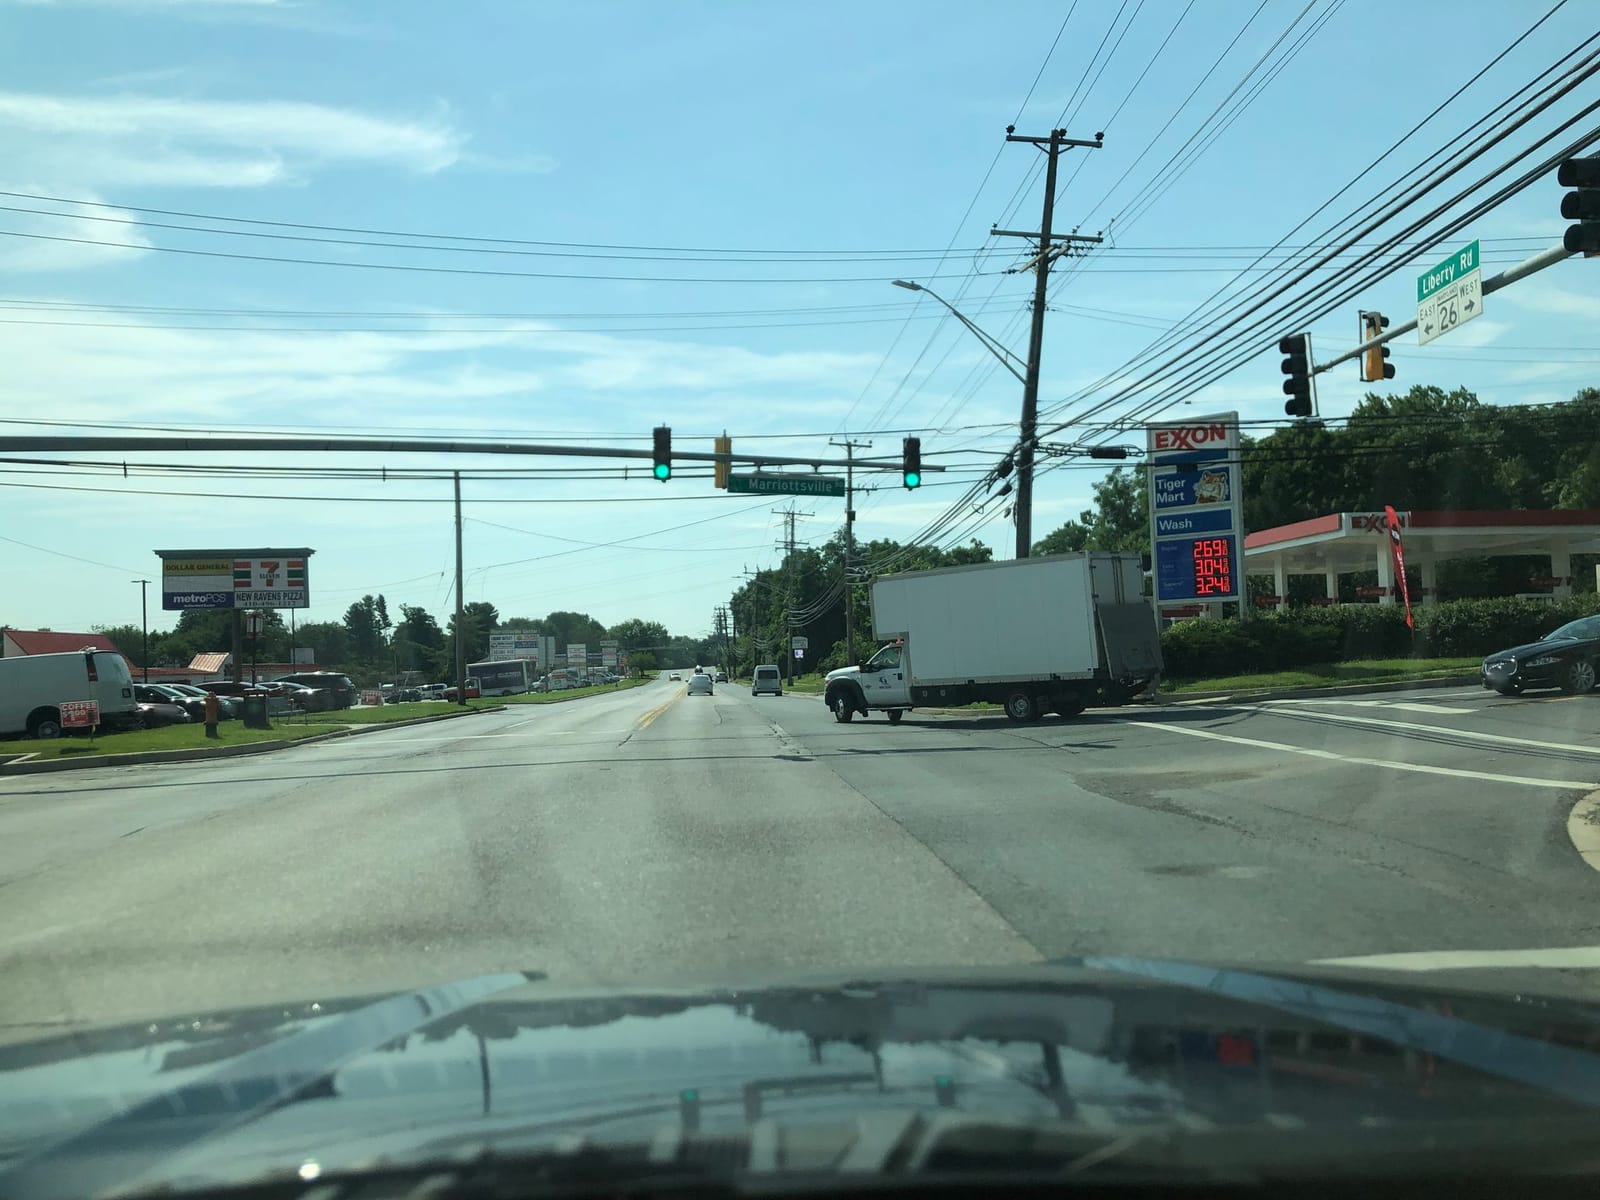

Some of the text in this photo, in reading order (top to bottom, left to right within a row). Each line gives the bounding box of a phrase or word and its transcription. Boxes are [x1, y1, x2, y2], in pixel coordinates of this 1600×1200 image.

[1422, 249, 1473, 295] Liberty Rd
[1459, 279, 1478, 298] WEST
[1419, 304, 1436, 321] EAST
[1439, 302, 1458, 331] 26
[1155, 423, 1226, 450] EXXON
[748, 478, 832, 492] Marriottsville
[1157, 479, 1186, 492] Tiger
[1156, 491, 1185, 504] Mart
[1159, 518, 1193, 531] Wash
[166, 562, 230, 571] DOLLAR GENERAL
[173, 593, 226, 603] metroPCS
[236, 591, 304, 601] NEW RAVENS PIZZA
[62, 701, 97, 711] COFFEE
